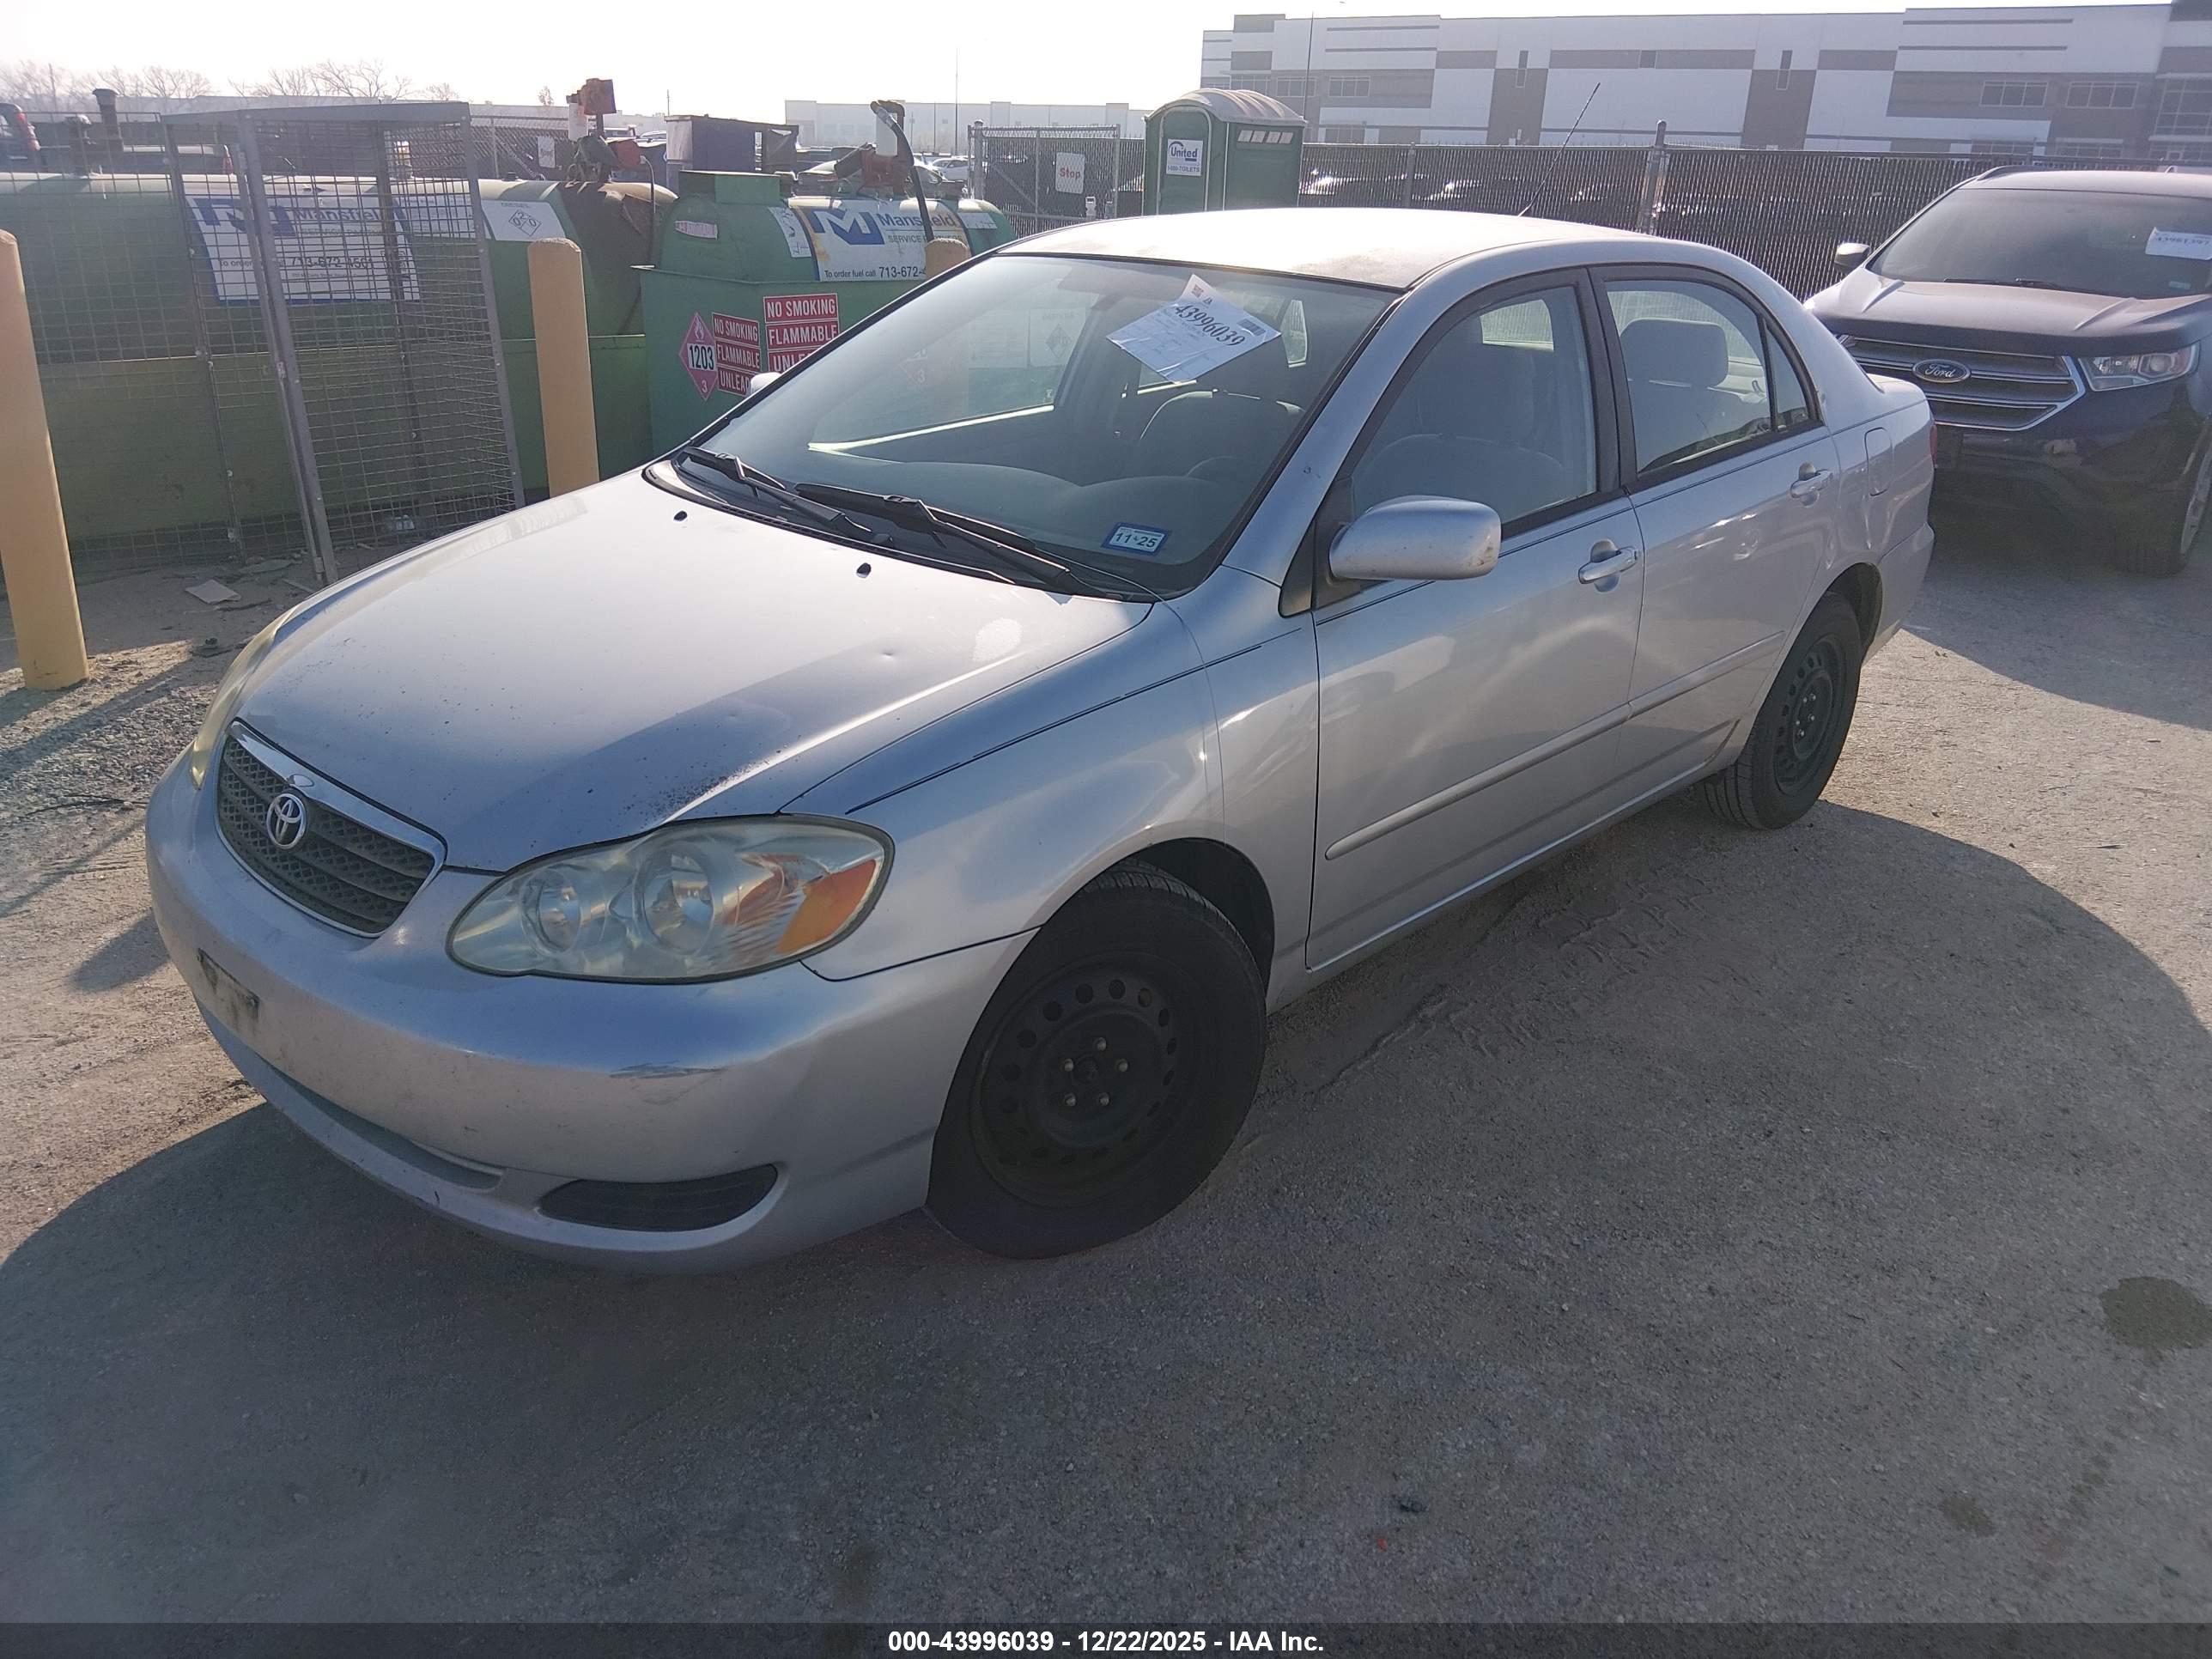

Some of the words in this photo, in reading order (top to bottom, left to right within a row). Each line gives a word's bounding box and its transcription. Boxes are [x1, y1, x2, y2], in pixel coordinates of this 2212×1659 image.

[1170, 146, 1198, 158] United
[1060, 167, 1081, 179] Stop
[513, 216, 521, 226] 0
[529, 217, 537, 228] 0
[516, 211, 526, 220] 2
[877, 212, 957, 228] Manseld
[824, 270, 833, 278] To
[834, 269, 851, 278] order
[852, 269, 864, 278] fuel
[865, 269, 876, 277] call
[767, 301, 782, 319] NO
[786, 298, 836, 318] SMOKING
[714, 318, 724, 336] NO
[725, 321, 758, 343] SMOKING
[1175, 305, 1245, 346] 43996039
[769, 324, 837, 346] FLAMMABLE
[689, 346, 714, 370] 1203
[717, 344, 760, 369] FLAMMABLE
[773, 353, 810, 372] UNLE
[1924, 363, 1956, 378] Ford
[702, 380, 708, 393] 3
